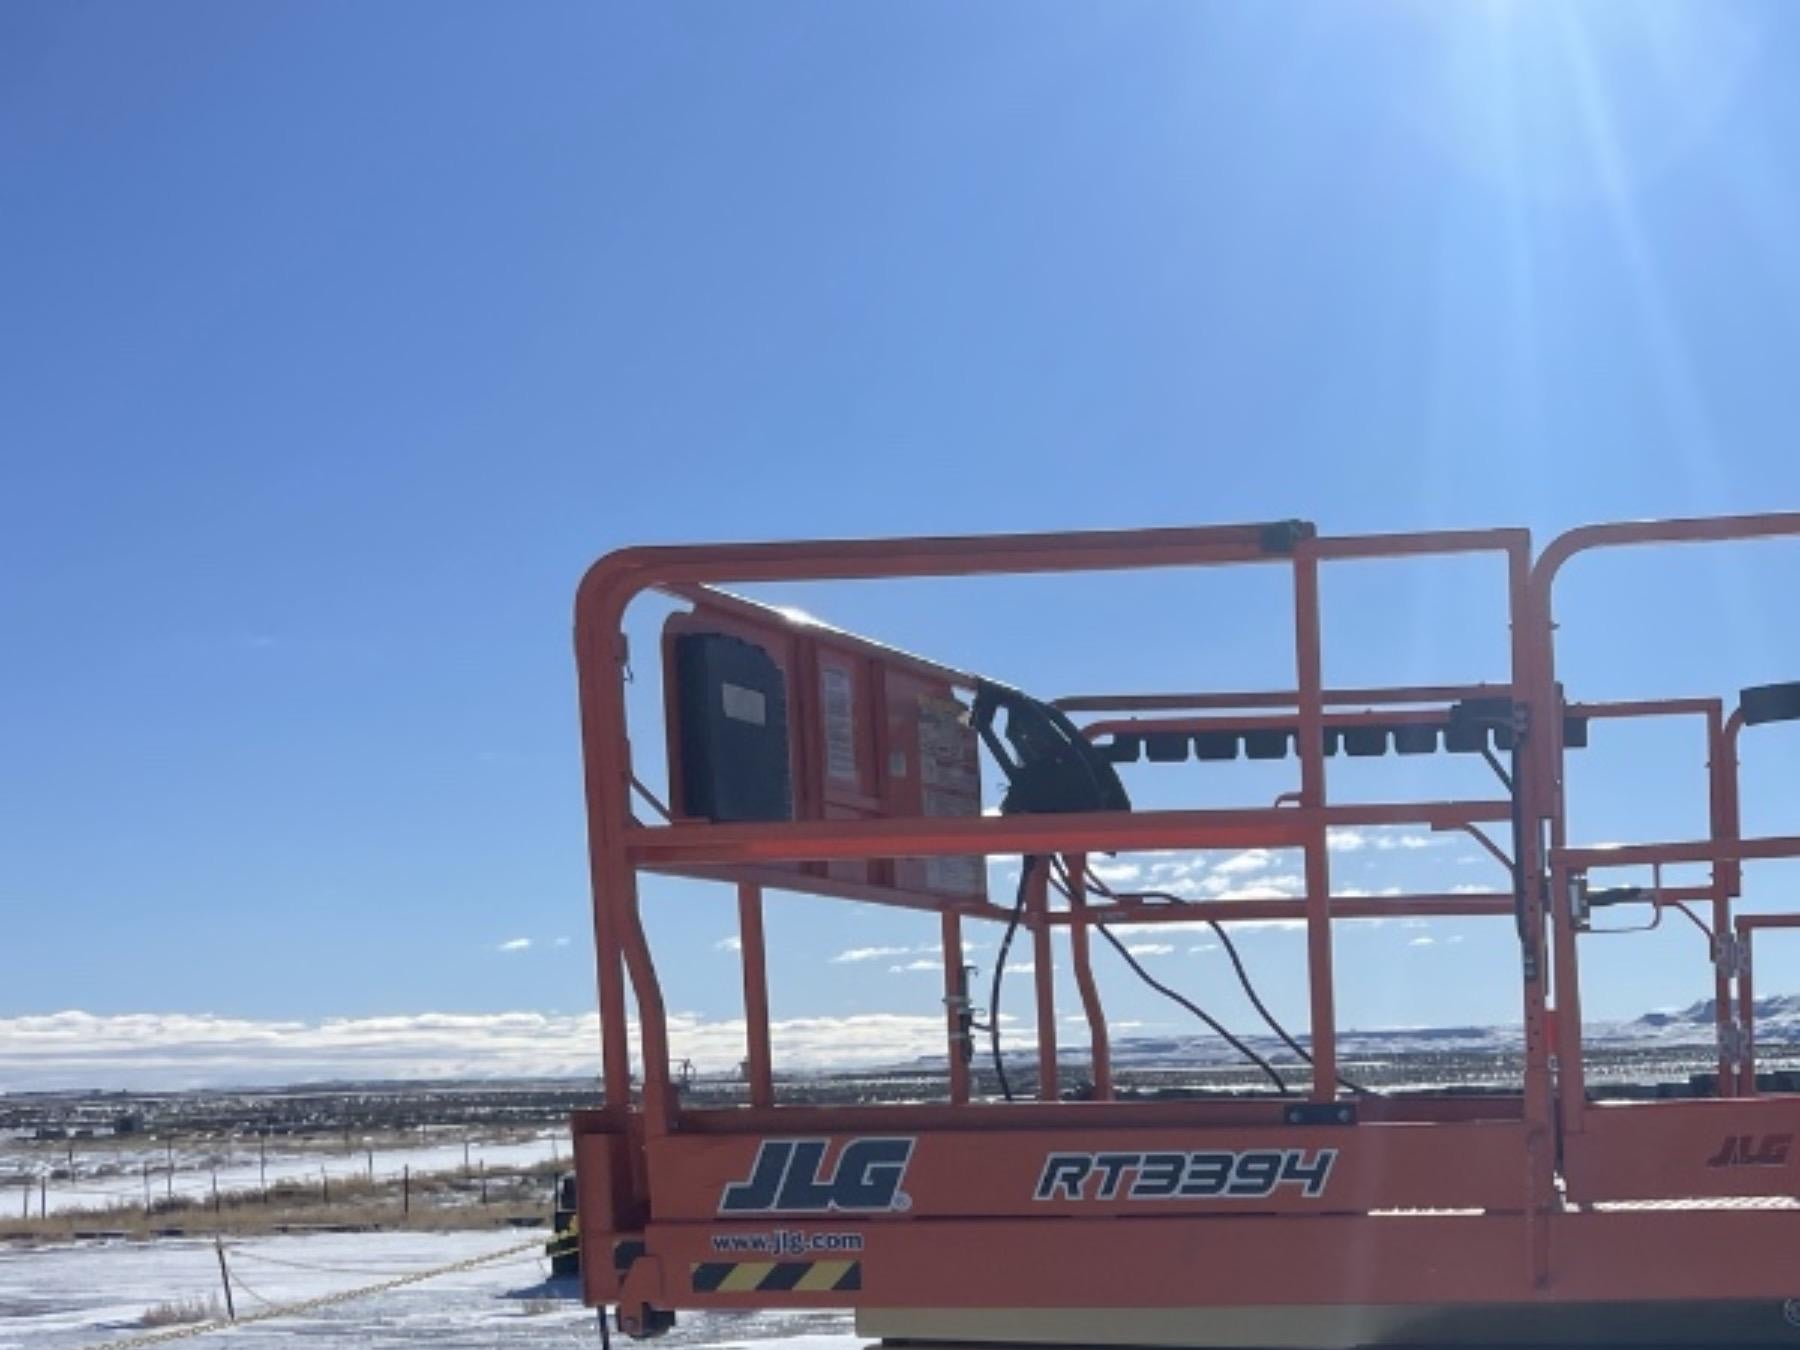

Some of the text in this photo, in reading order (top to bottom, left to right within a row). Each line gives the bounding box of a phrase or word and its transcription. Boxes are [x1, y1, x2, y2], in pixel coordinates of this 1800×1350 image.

[1705, 1133, 1794, 1168] JLG
[717, 1136, 916, 1213] JLG
[1032, 1149, 1339, 1200] RT3394
[712, 1229, 863, 1255] www.jlg.com
